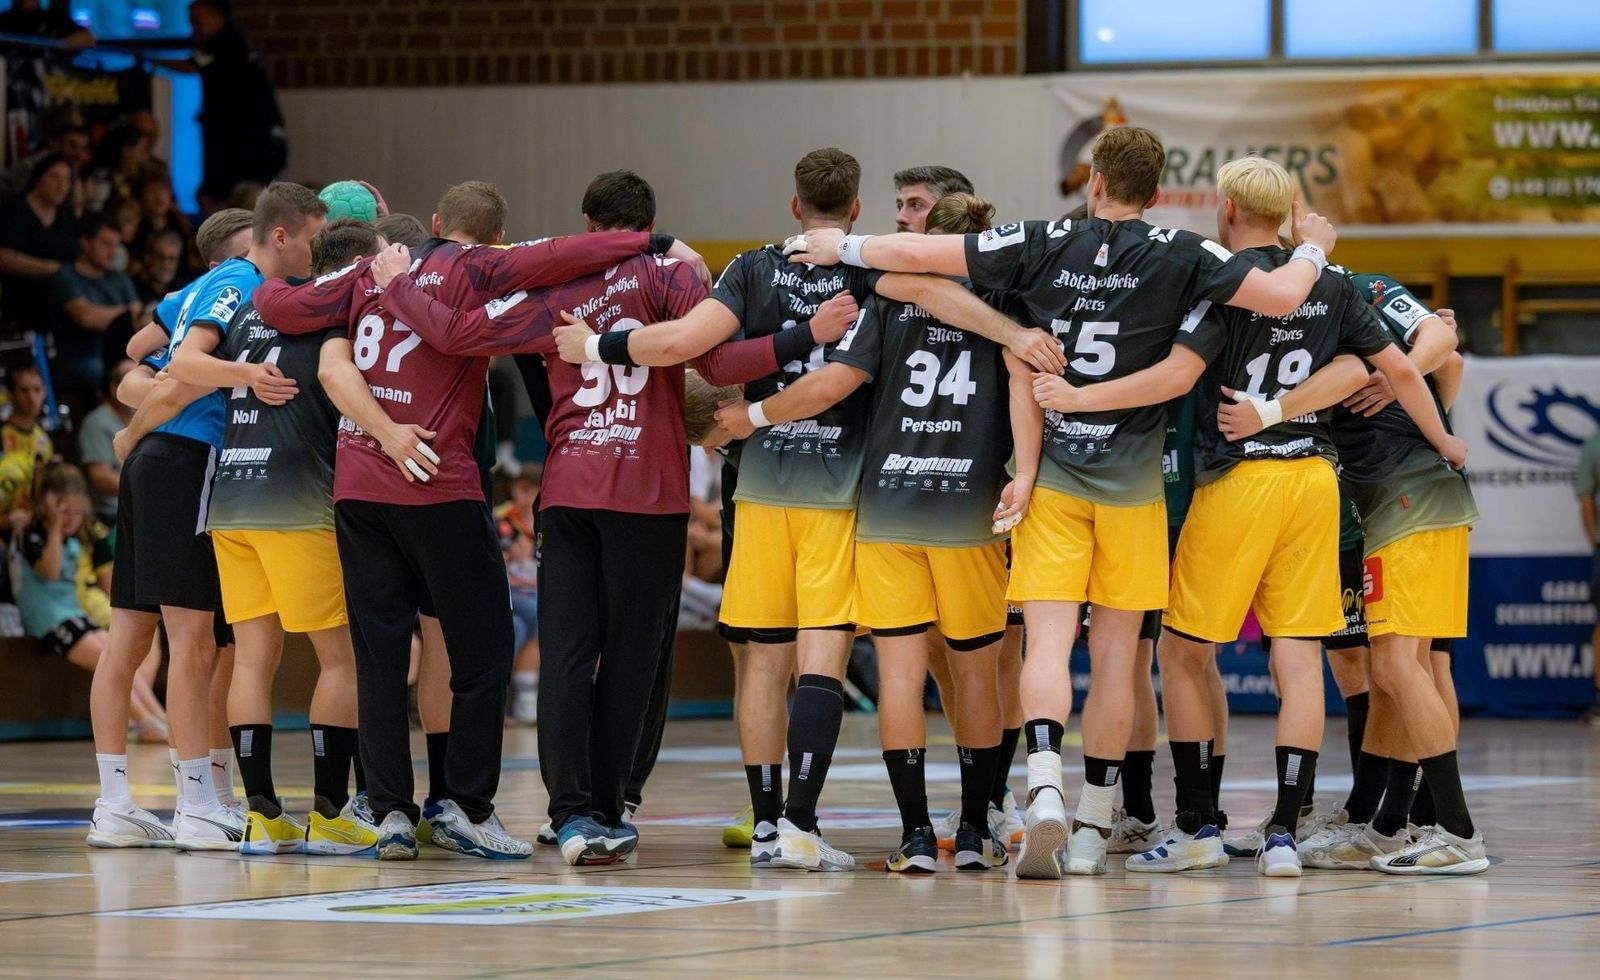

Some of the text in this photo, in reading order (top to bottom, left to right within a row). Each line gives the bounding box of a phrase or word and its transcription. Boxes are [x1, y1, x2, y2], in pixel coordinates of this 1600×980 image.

[605, 275, 639, 298] pothek
[801, 275, 844, 297] potheke
[788, 293, 819, 315] Moer
[354, 314, 421, 373] 87
[901, 350, 976, 407] 34
[369, 384, 412, 405] mann
[232, 409, 259, 425] Noll
[584, 399, 637, 428] Jakbi
[901, 417, 961, 433] Persson
[220, 447, 273, 466] rgmann
[1162, 449, 1179, 474] el
[1165, 472, 1180, 483] au
[1345, 611, 1360, 623] ael
